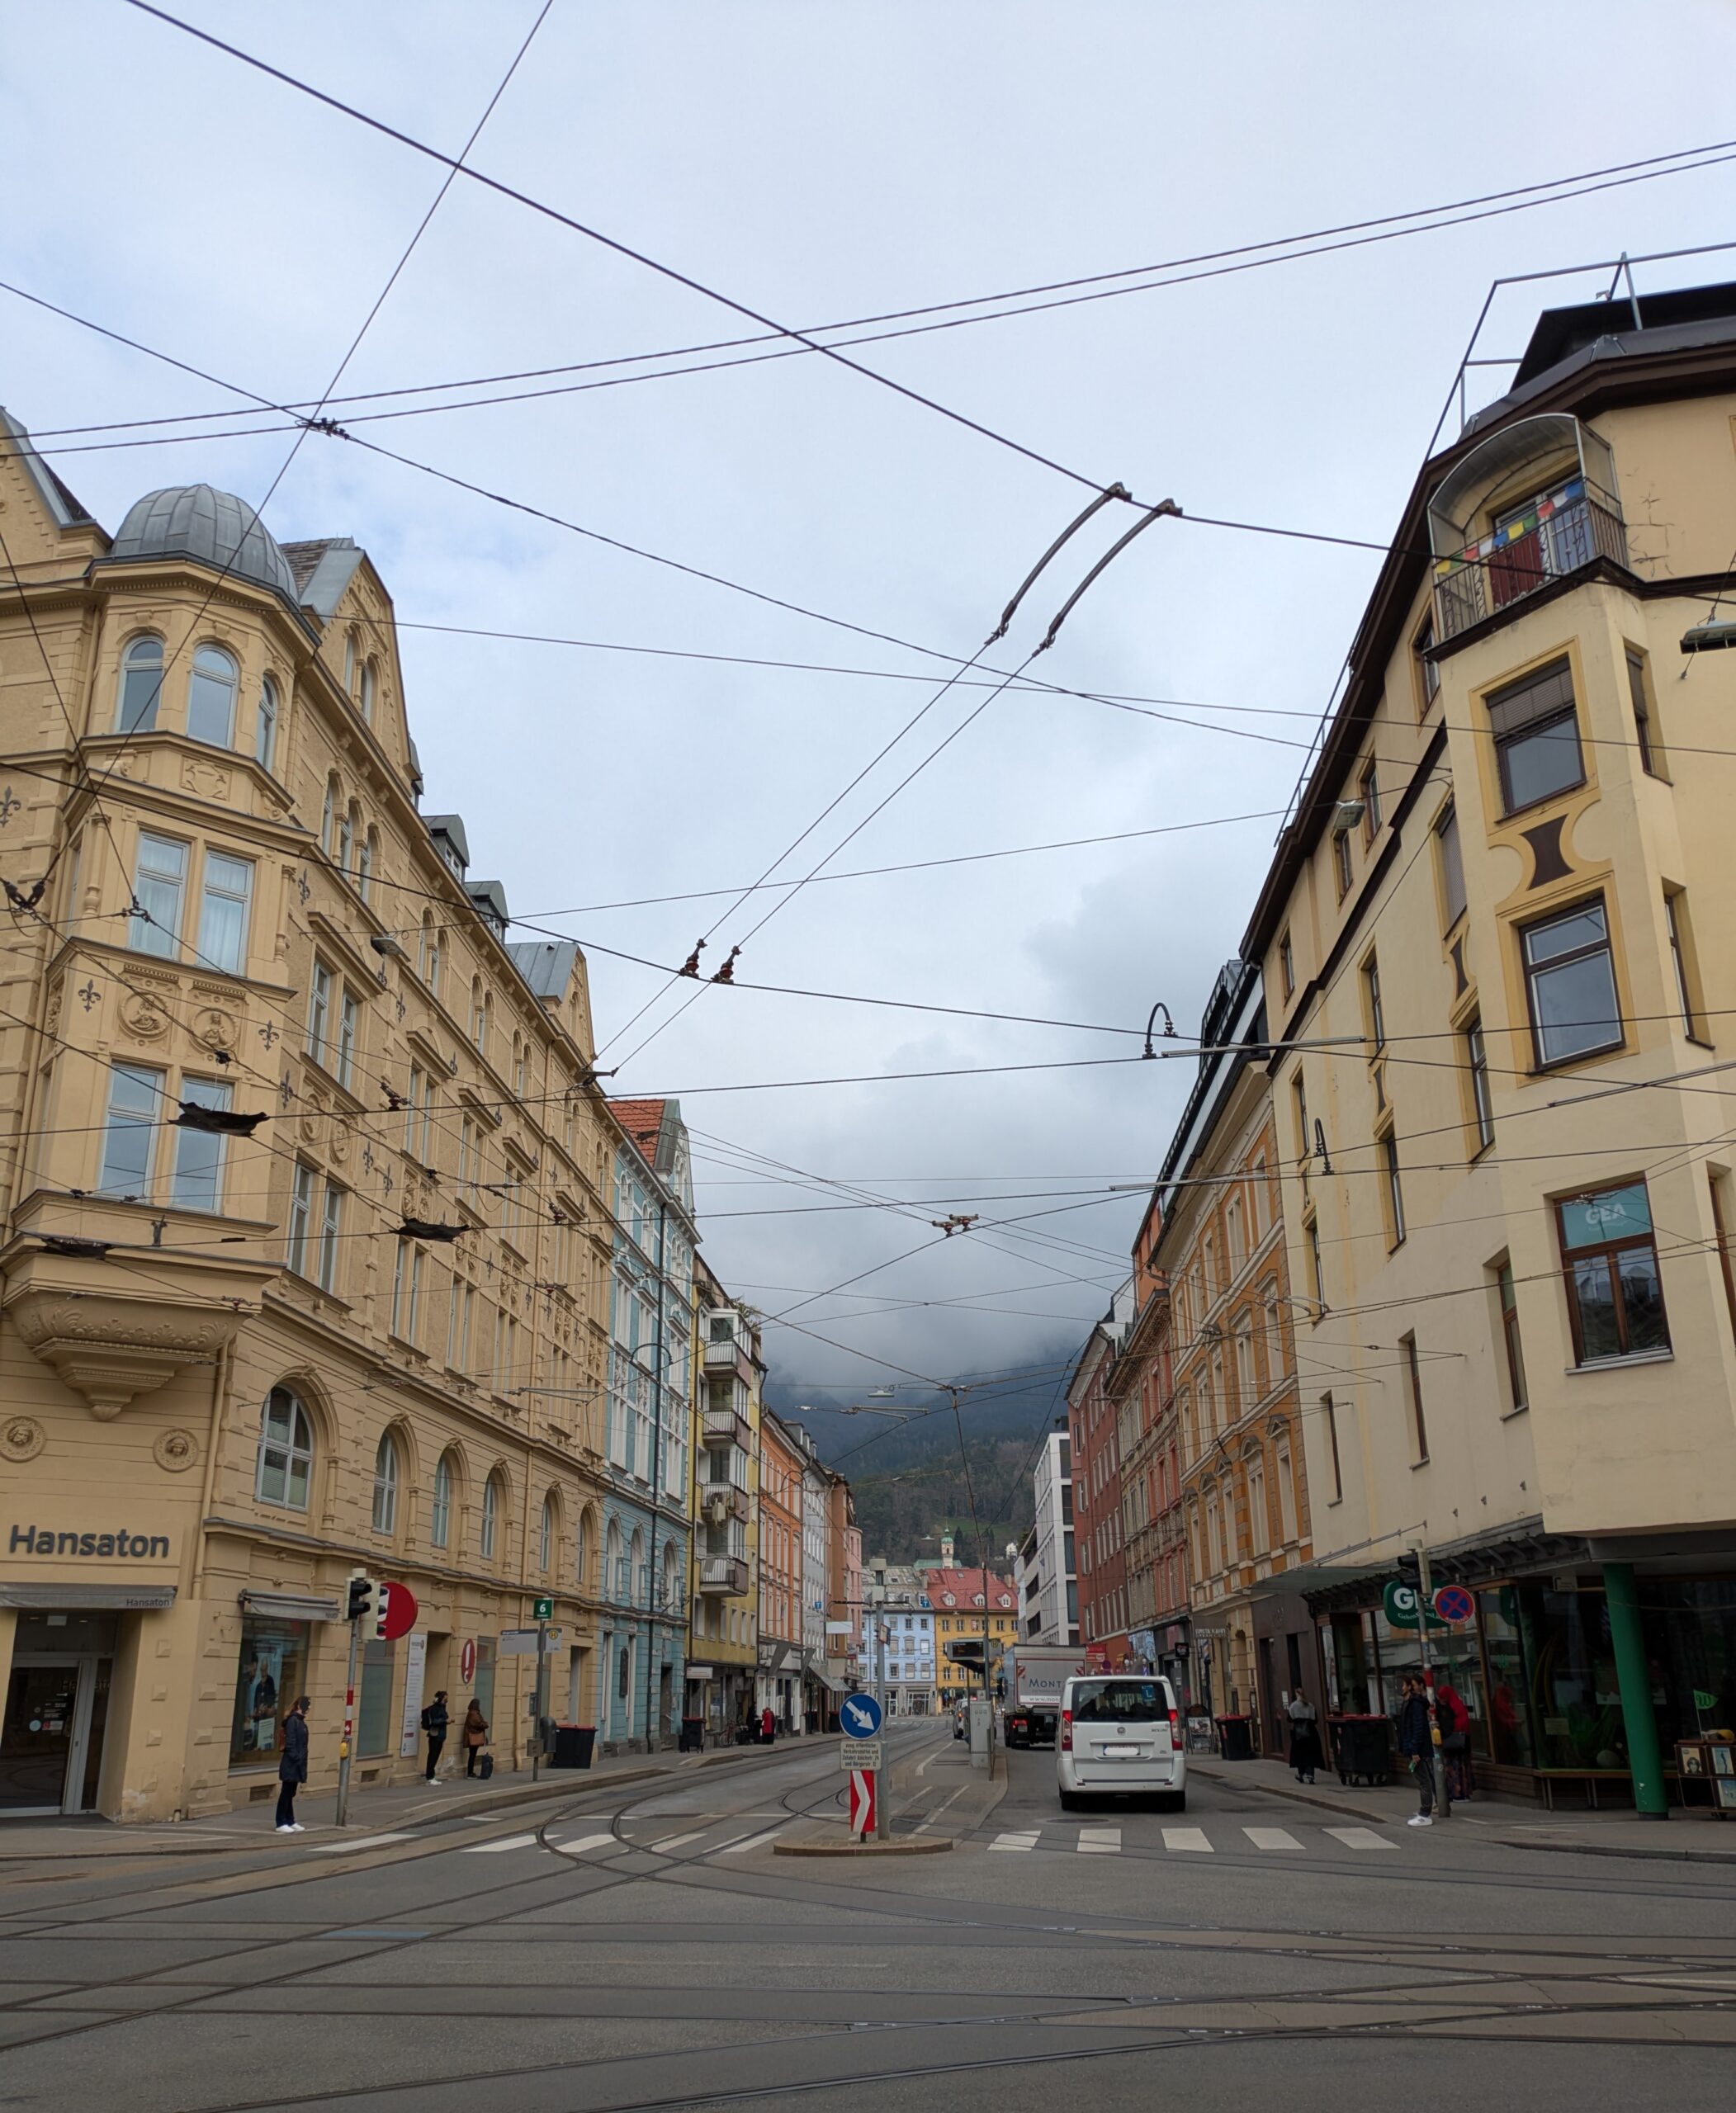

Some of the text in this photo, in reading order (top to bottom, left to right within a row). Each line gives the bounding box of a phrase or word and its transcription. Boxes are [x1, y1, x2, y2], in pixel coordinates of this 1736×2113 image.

[1585, 1203, 1626, 1225] GEA
[9, 1524, 169, 1558] Hansaton
[126, 1598, 170, 1606] Hansaton
[539, 1604, 546, 1613] 6
